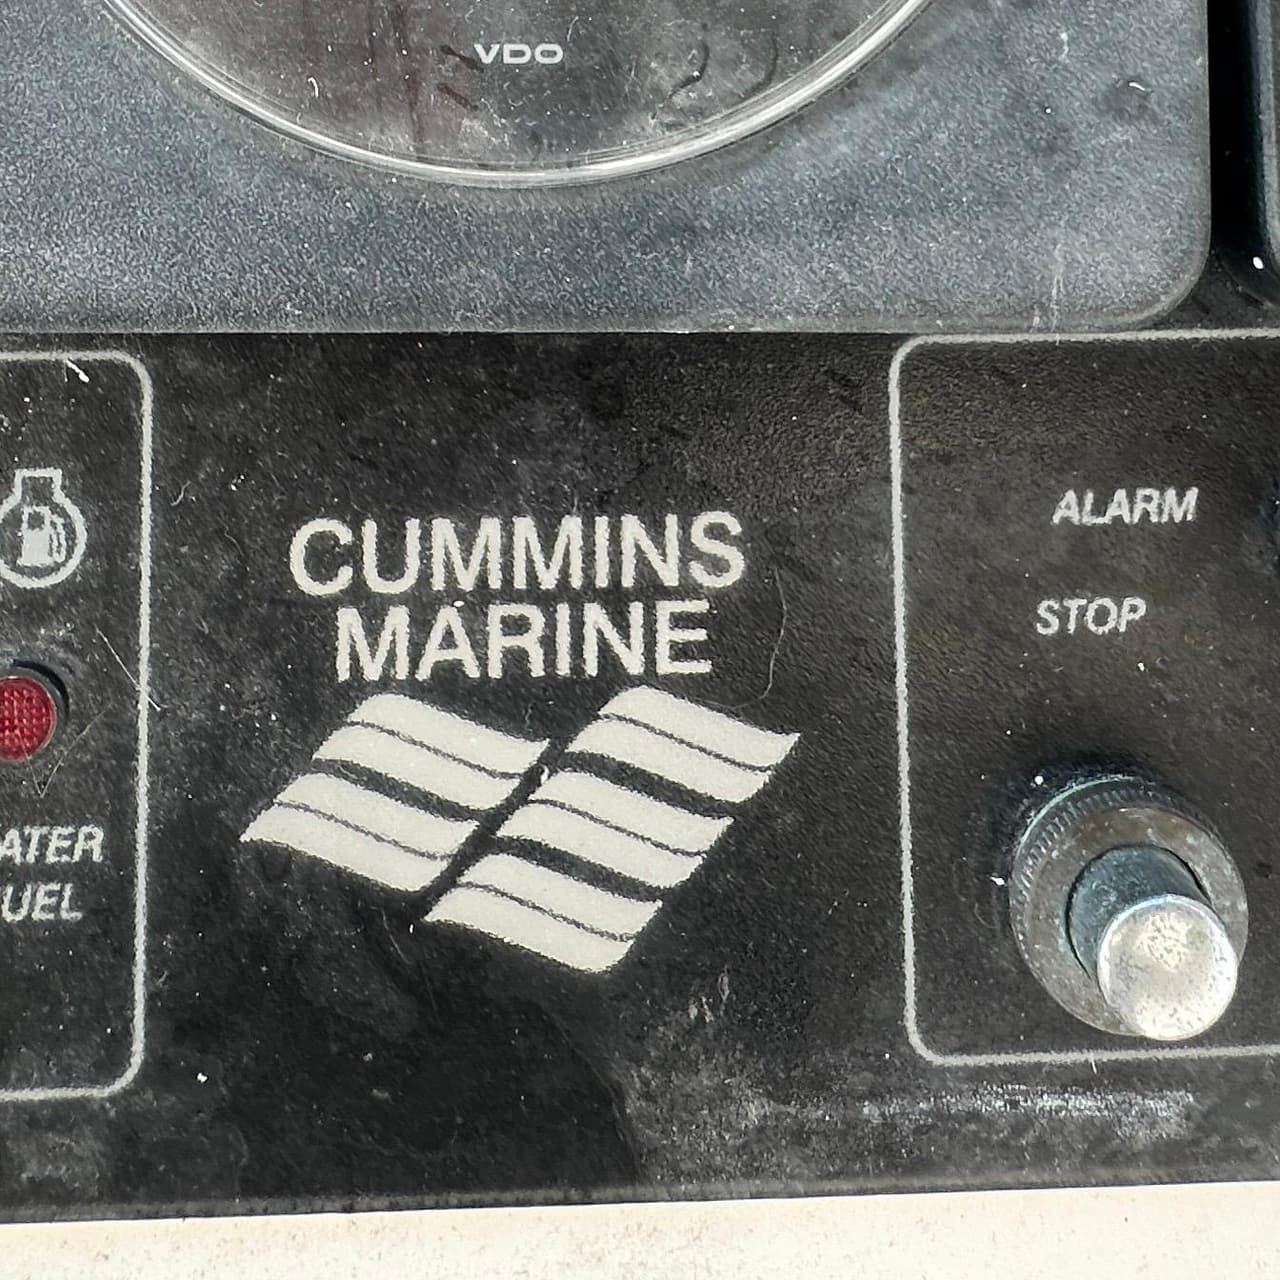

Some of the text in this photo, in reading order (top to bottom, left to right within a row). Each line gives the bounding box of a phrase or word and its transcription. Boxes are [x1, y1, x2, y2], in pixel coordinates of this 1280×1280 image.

[474, 43, 564, 65] VDO
[1052, 486, 1199, 525] ALARM
[289, 510, 746, 596] CUMMINS
[1035, 597, 1148, 636] STOP
[334, 598, 713, 683] MARINE
